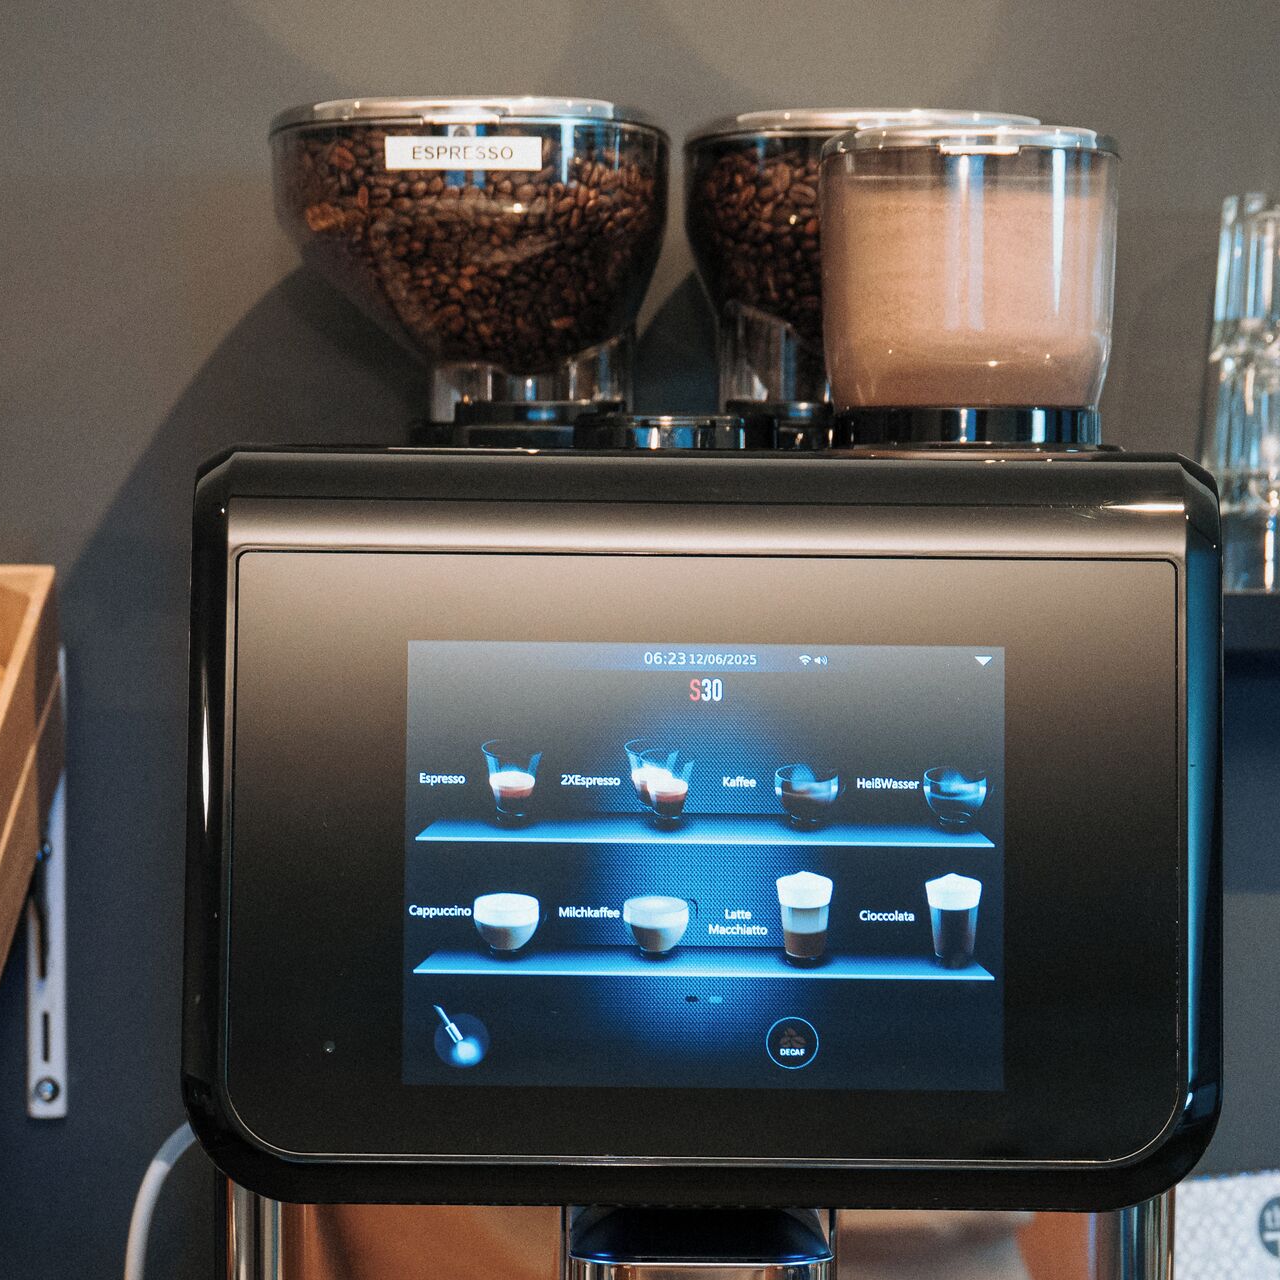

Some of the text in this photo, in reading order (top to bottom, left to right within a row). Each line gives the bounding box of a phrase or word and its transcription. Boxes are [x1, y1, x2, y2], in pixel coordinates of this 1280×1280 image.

[412, 145, 514, 160] ESPRESSO
[644, 652, 757, 665] 06:23 12/06/2025
[690, 678, 723, 702] S30
[419, 772, 466, 786] Espresso
[561, 774, 621, 788] 2XEspresso
[722, 777, 757, 788] Kaffee
[408, 905, 472, 919] Cappuccino
[558, 905, 621, 919] Milchkaffee
[724, 908, 752, 920] Latte
[859, 909, 915, 923] Cioccolata
[708, 924, 768, 936] Macchiatto
[780, 1048, 805, 1056] DECAF
